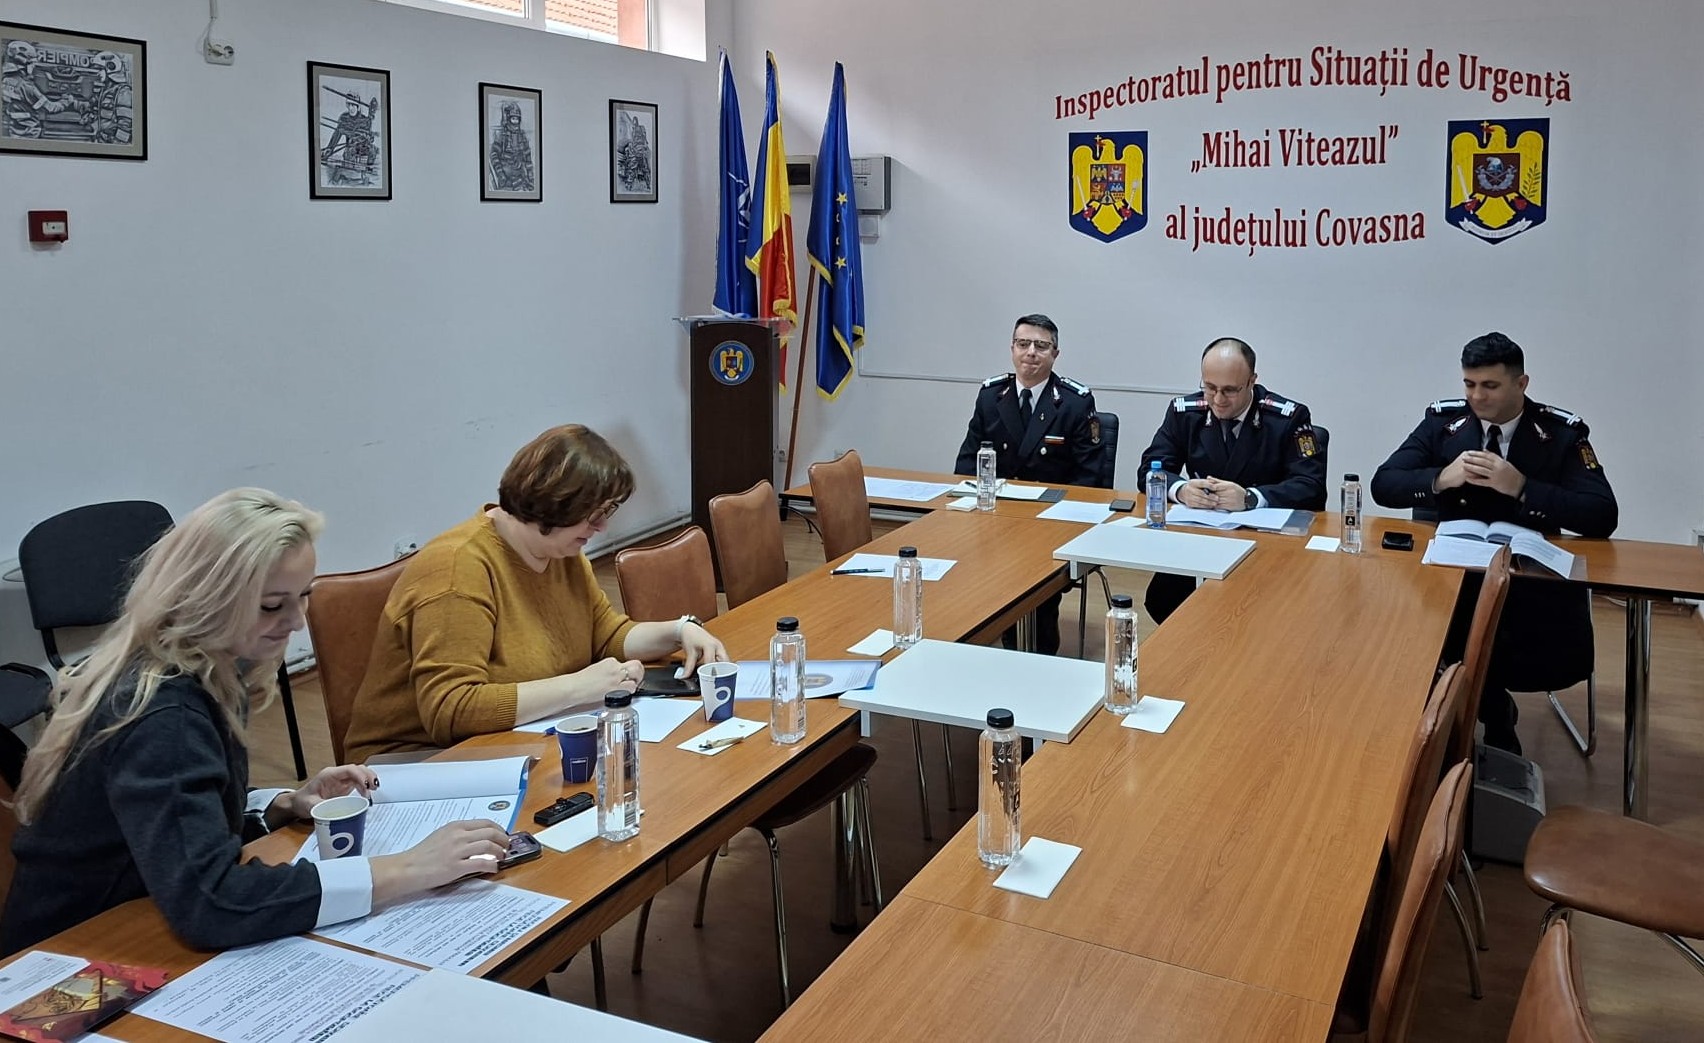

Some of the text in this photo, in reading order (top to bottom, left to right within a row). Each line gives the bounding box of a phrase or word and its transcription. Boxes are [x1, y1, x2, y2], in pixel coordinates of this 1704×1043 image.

[1055, 45, 1572, 121] Inspectoratul pentru Situații de Urgență
[1165, 204, 1187, 240] al
[1192, 206, 1307, 257] județului
[1315, 207, 1426, 248] Covasna
